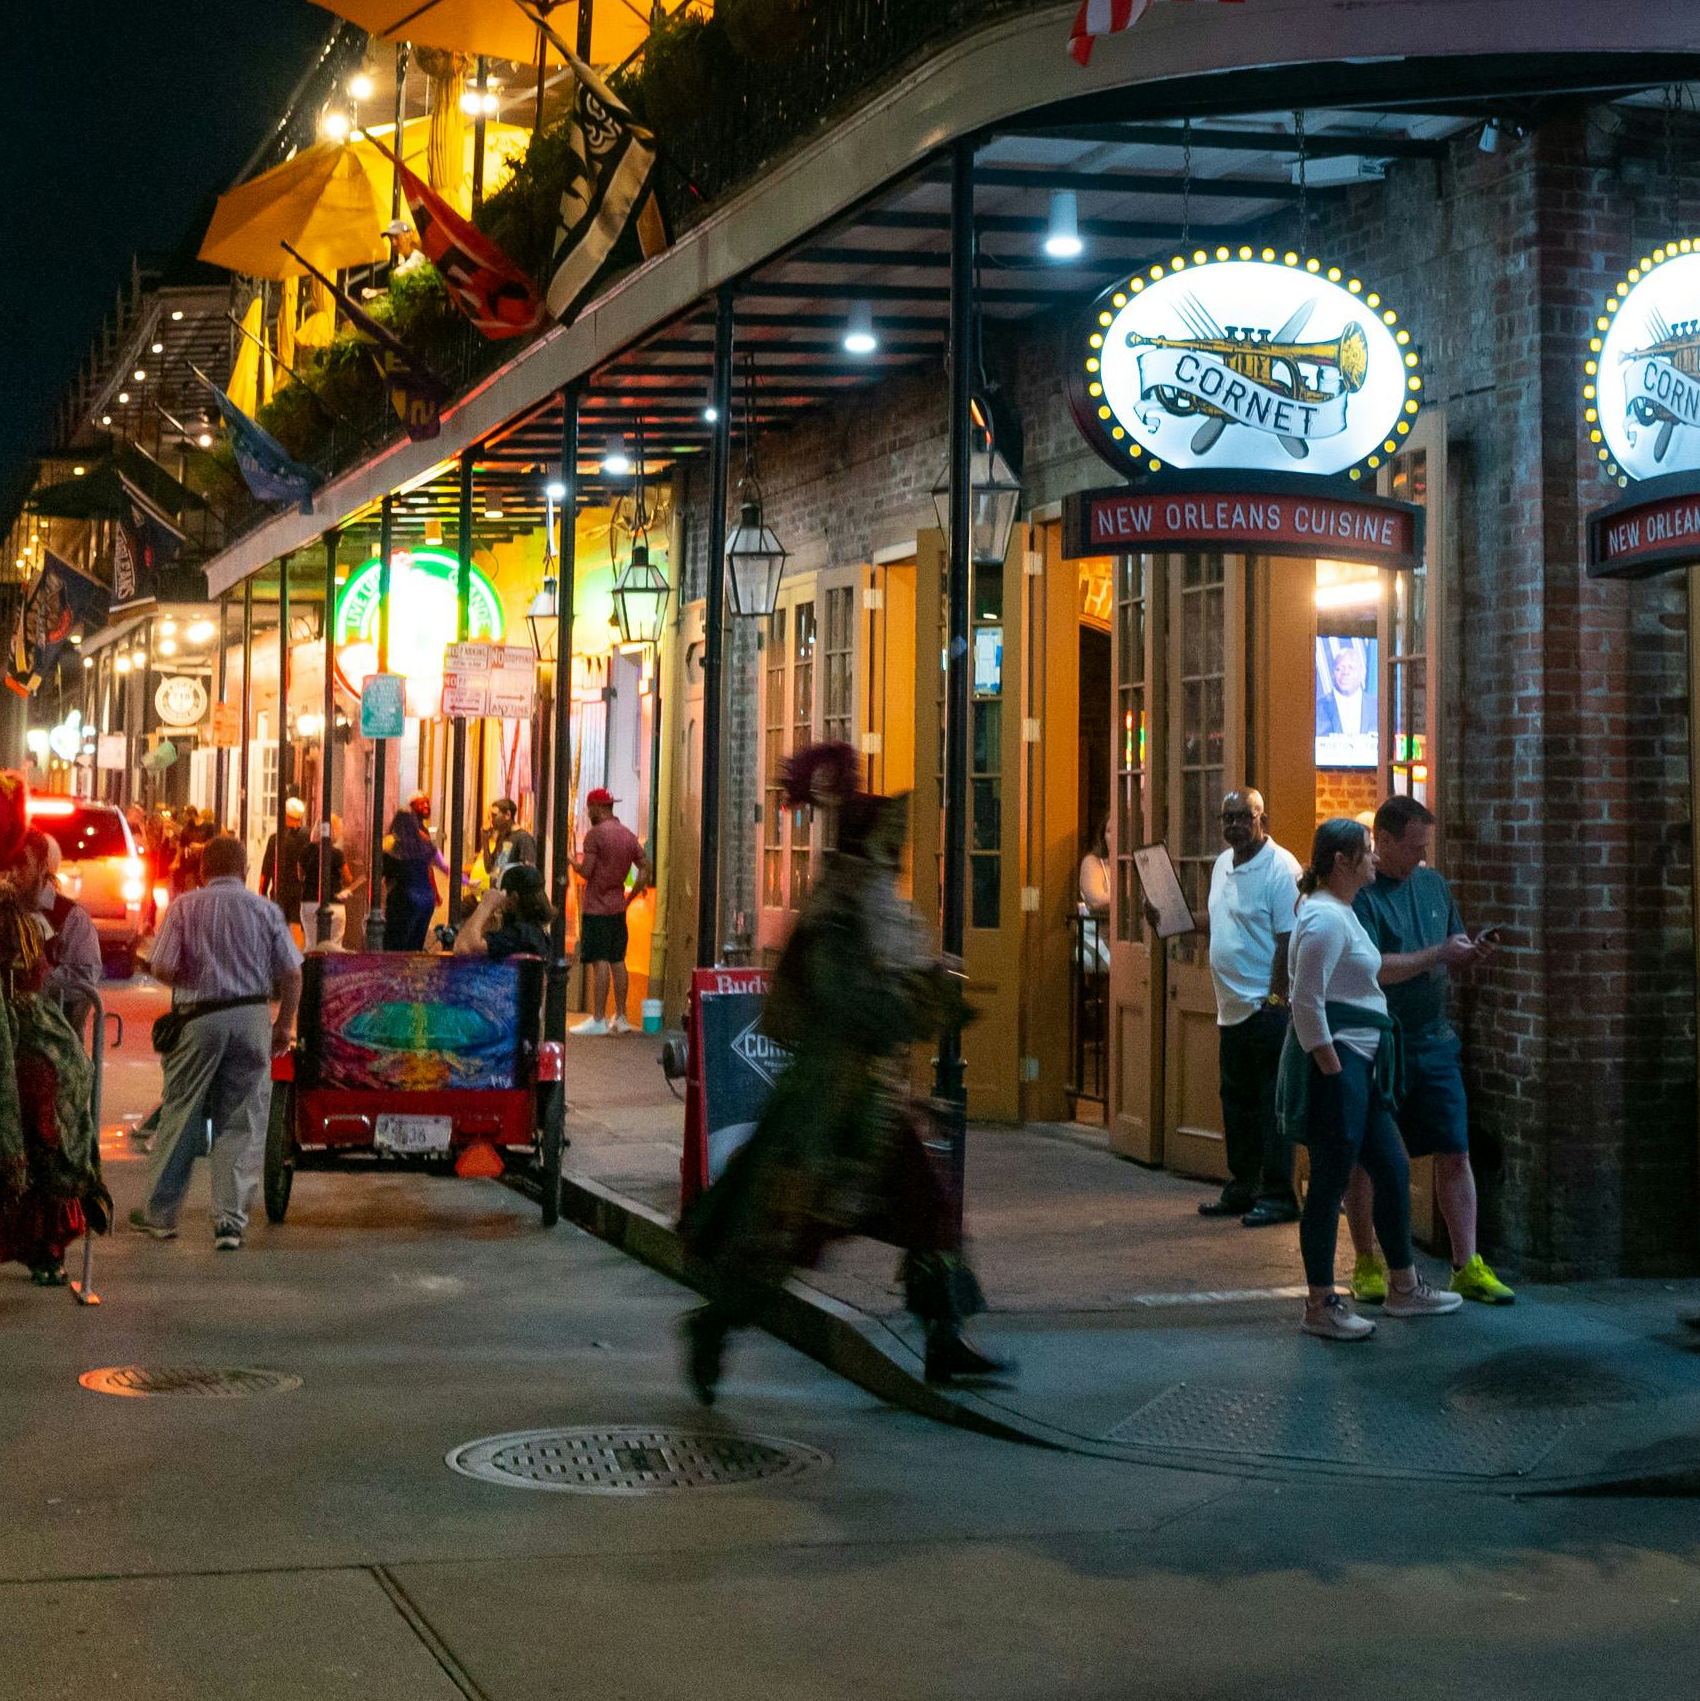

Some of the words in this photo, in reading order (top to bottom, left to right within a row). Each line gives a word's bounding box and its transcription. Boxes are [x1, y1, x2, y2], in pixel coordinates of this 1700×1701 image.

[1175, 355, 1317, 435] CORNET
[1098, 506, 1151, 535] NEW
[1166, 502, 1281, 531] ORLEANS
[1294, 506, 1393, 545] CUISINE
[1609, 521, 1640, 555] NEW
